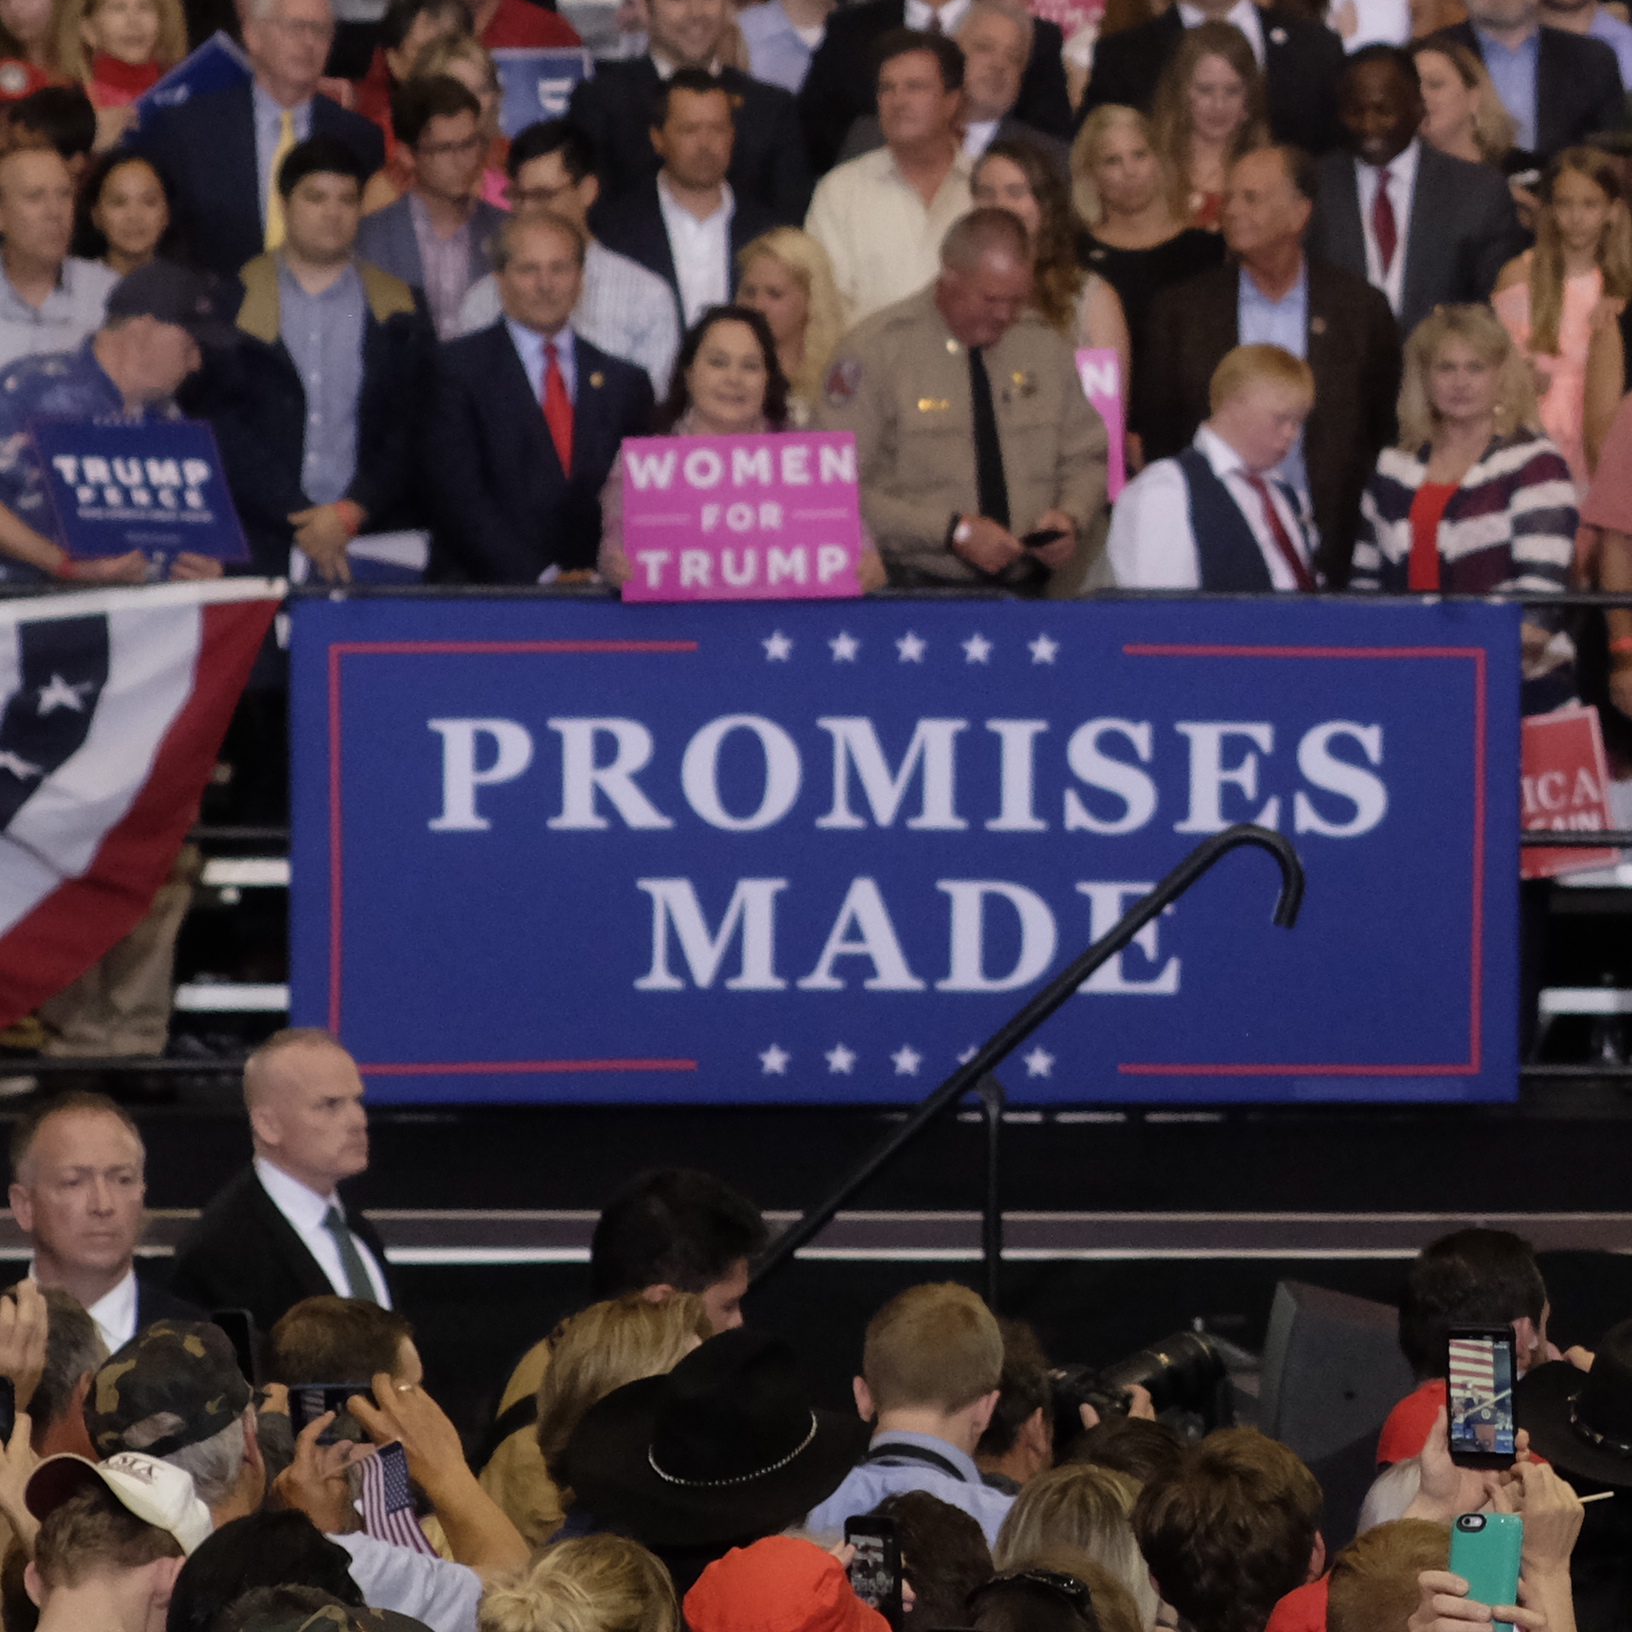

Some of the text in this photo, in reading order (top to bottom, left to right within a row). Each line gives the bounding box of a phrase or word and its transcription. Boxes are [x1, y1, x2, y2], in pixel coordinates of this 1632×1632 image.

[52, 453, 212, 488] TRUMP
[625, 444, 859, 492] WOMEN
[700, 501, 785, 534] FOR
[634, 543, 850, 592] TRUMP
[428, 714, 1388, 838] PROMISES
[634, 876, 1182, 996] MADE
